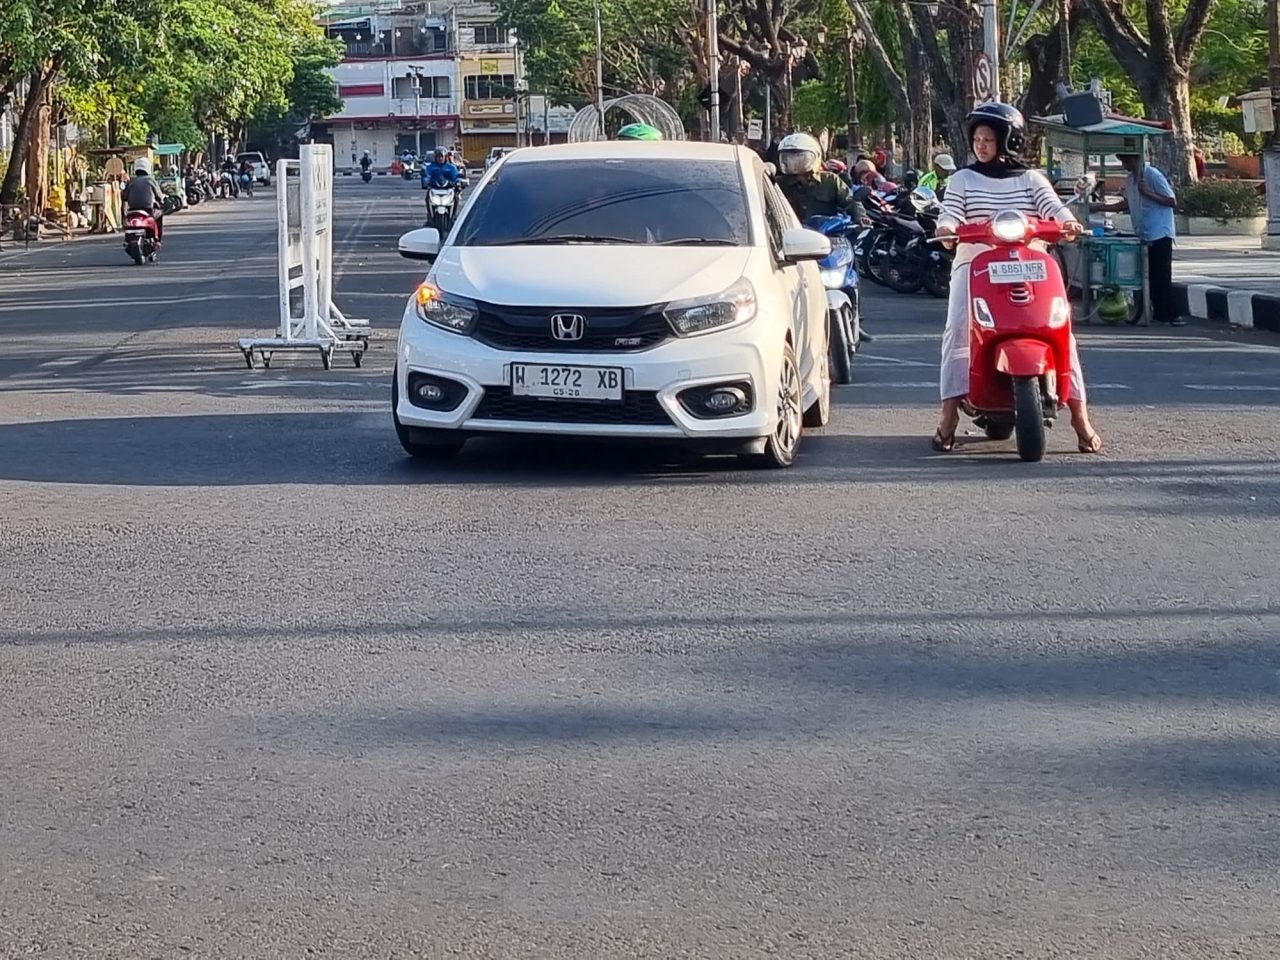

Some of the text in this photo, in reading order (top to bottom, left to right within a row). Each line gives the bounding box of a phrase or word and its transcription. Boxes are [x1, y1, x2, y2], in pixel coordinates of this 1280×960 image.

[991, 264, 998, 275] W
[515, 366, 619, 389] W 1272 XB
